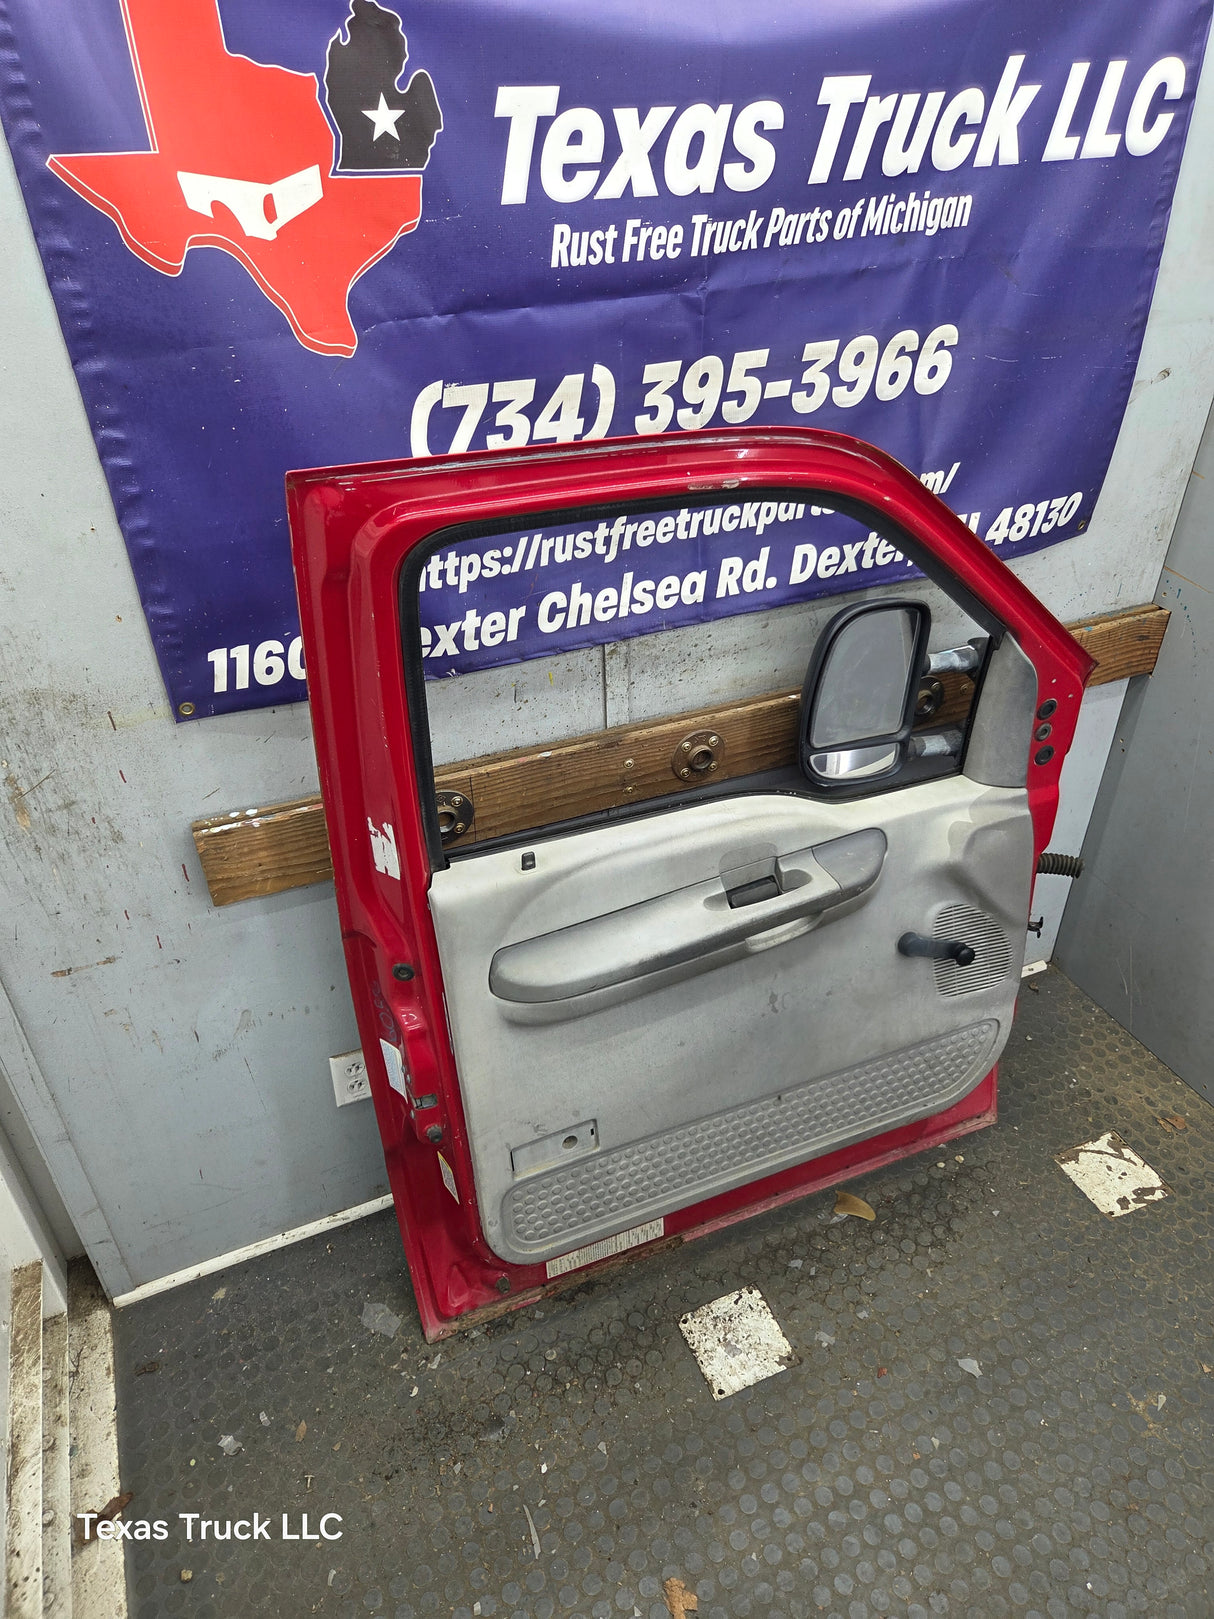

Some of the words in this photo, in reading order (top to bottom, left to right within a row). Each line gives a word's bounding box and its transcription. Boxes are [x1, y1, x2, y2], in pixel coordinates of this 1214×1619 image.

[493, 85, 785, 206] Texas
[807, 54, 1043, 185] Truck
[1041, 56, 1187, 163] LLC
[550, 223, 619, 268] Rust
[621, 218, 684, 263] Free
[690, 209, 764, 257] Truck
[762, 206, 833, 248] Parts
[833, 198, 865, 241] of
[860, 190, 973, 237] Michigan
[410, 363, 616, 457] (734)
[634, 323, 959, 436] 395-3966
[418, 501, 835, 594] ttps://rustfreetruckpar
[537, 569, 708, 634] Chelsea
[715, 545, 778, 599] Rd.
[984, 491, 1084, 546] 48130
